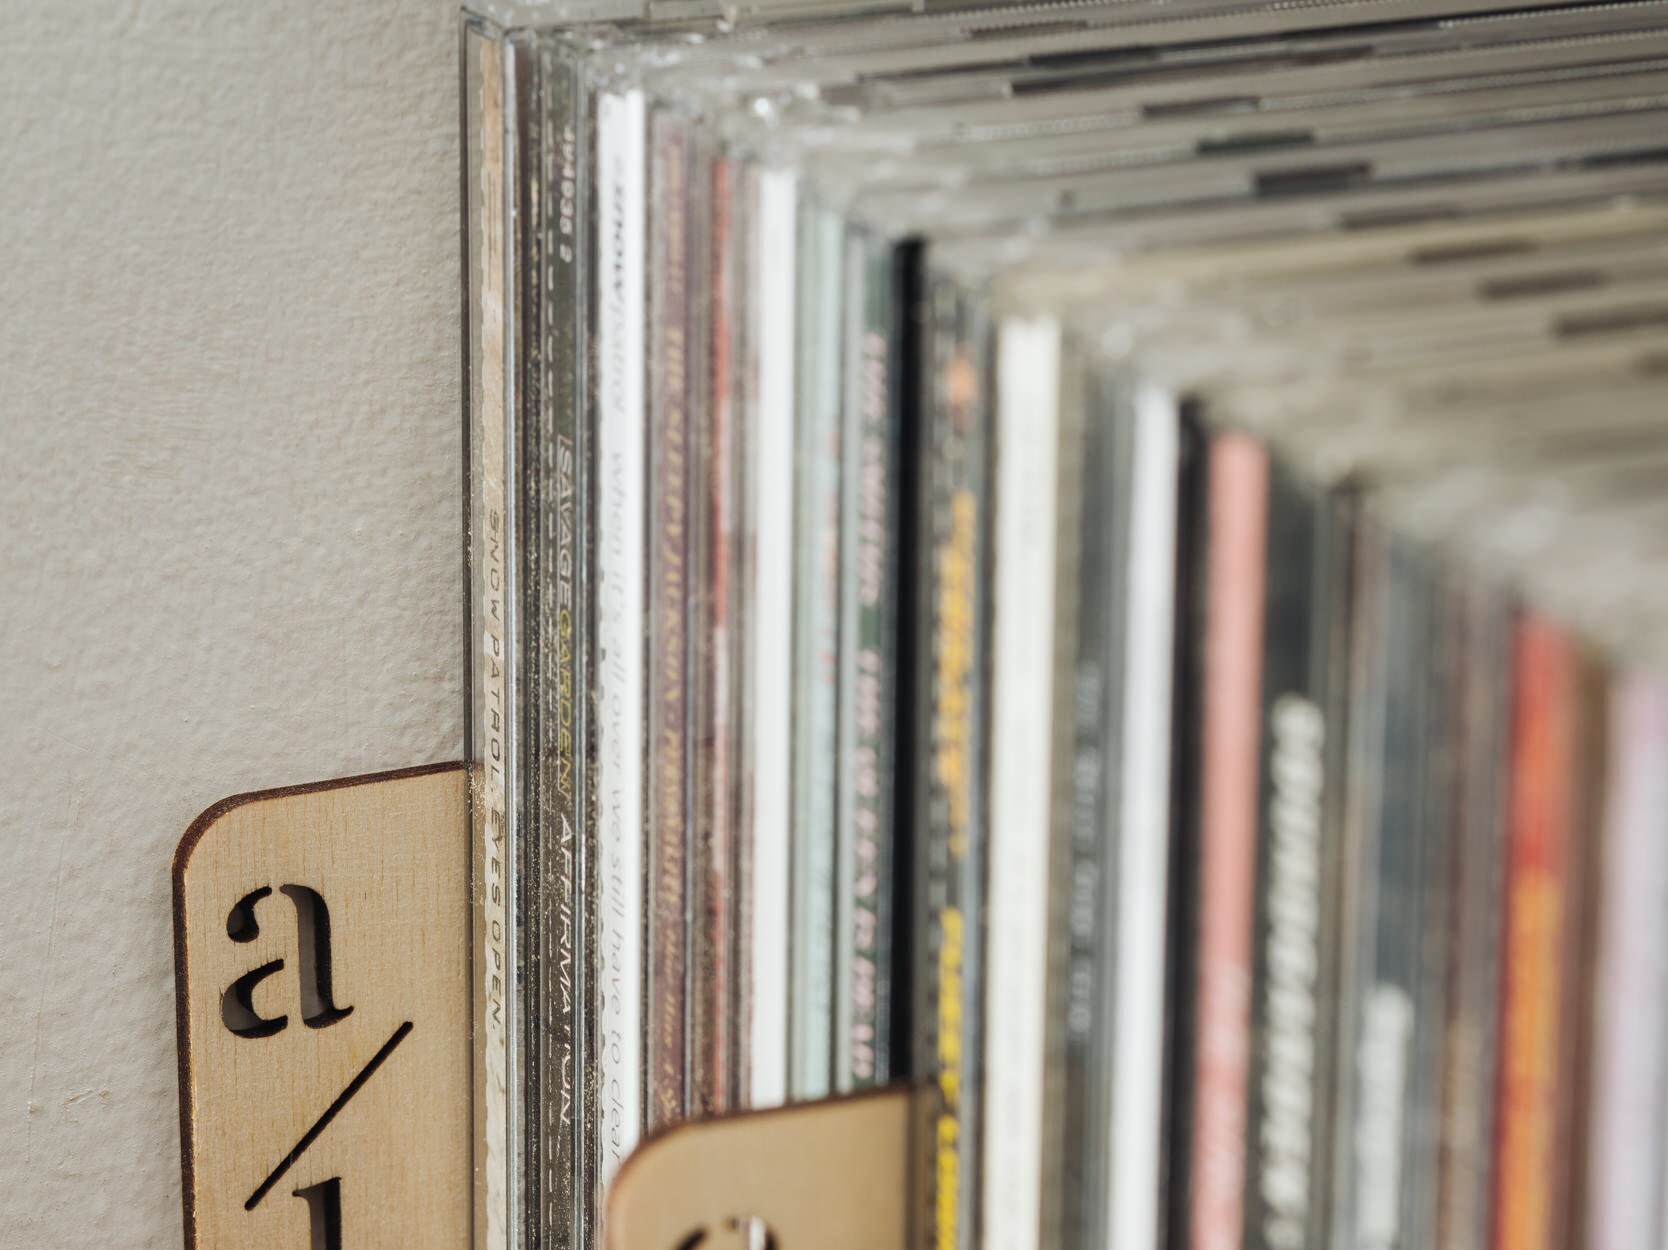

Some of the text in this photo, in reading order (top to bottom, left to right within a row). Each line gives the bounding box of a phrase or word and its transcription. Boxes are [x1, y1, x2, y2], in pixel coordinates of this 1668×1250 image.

[611, 451, 627, 557] when
[489, 508, 502, 621] SNOW
[611, 570, 627, 624] it's
[611, 638, 627, 684] all
[611, 694, 623, 773] over
[611, 788, 622, 842] we
[490, 807, 502, 908] EYES
[610, 851, 625, 918] still
[610, 927, 625, 1015] have
[610, 1030, 624, 1064] to
[610, 1077, 625, 1168] clear
